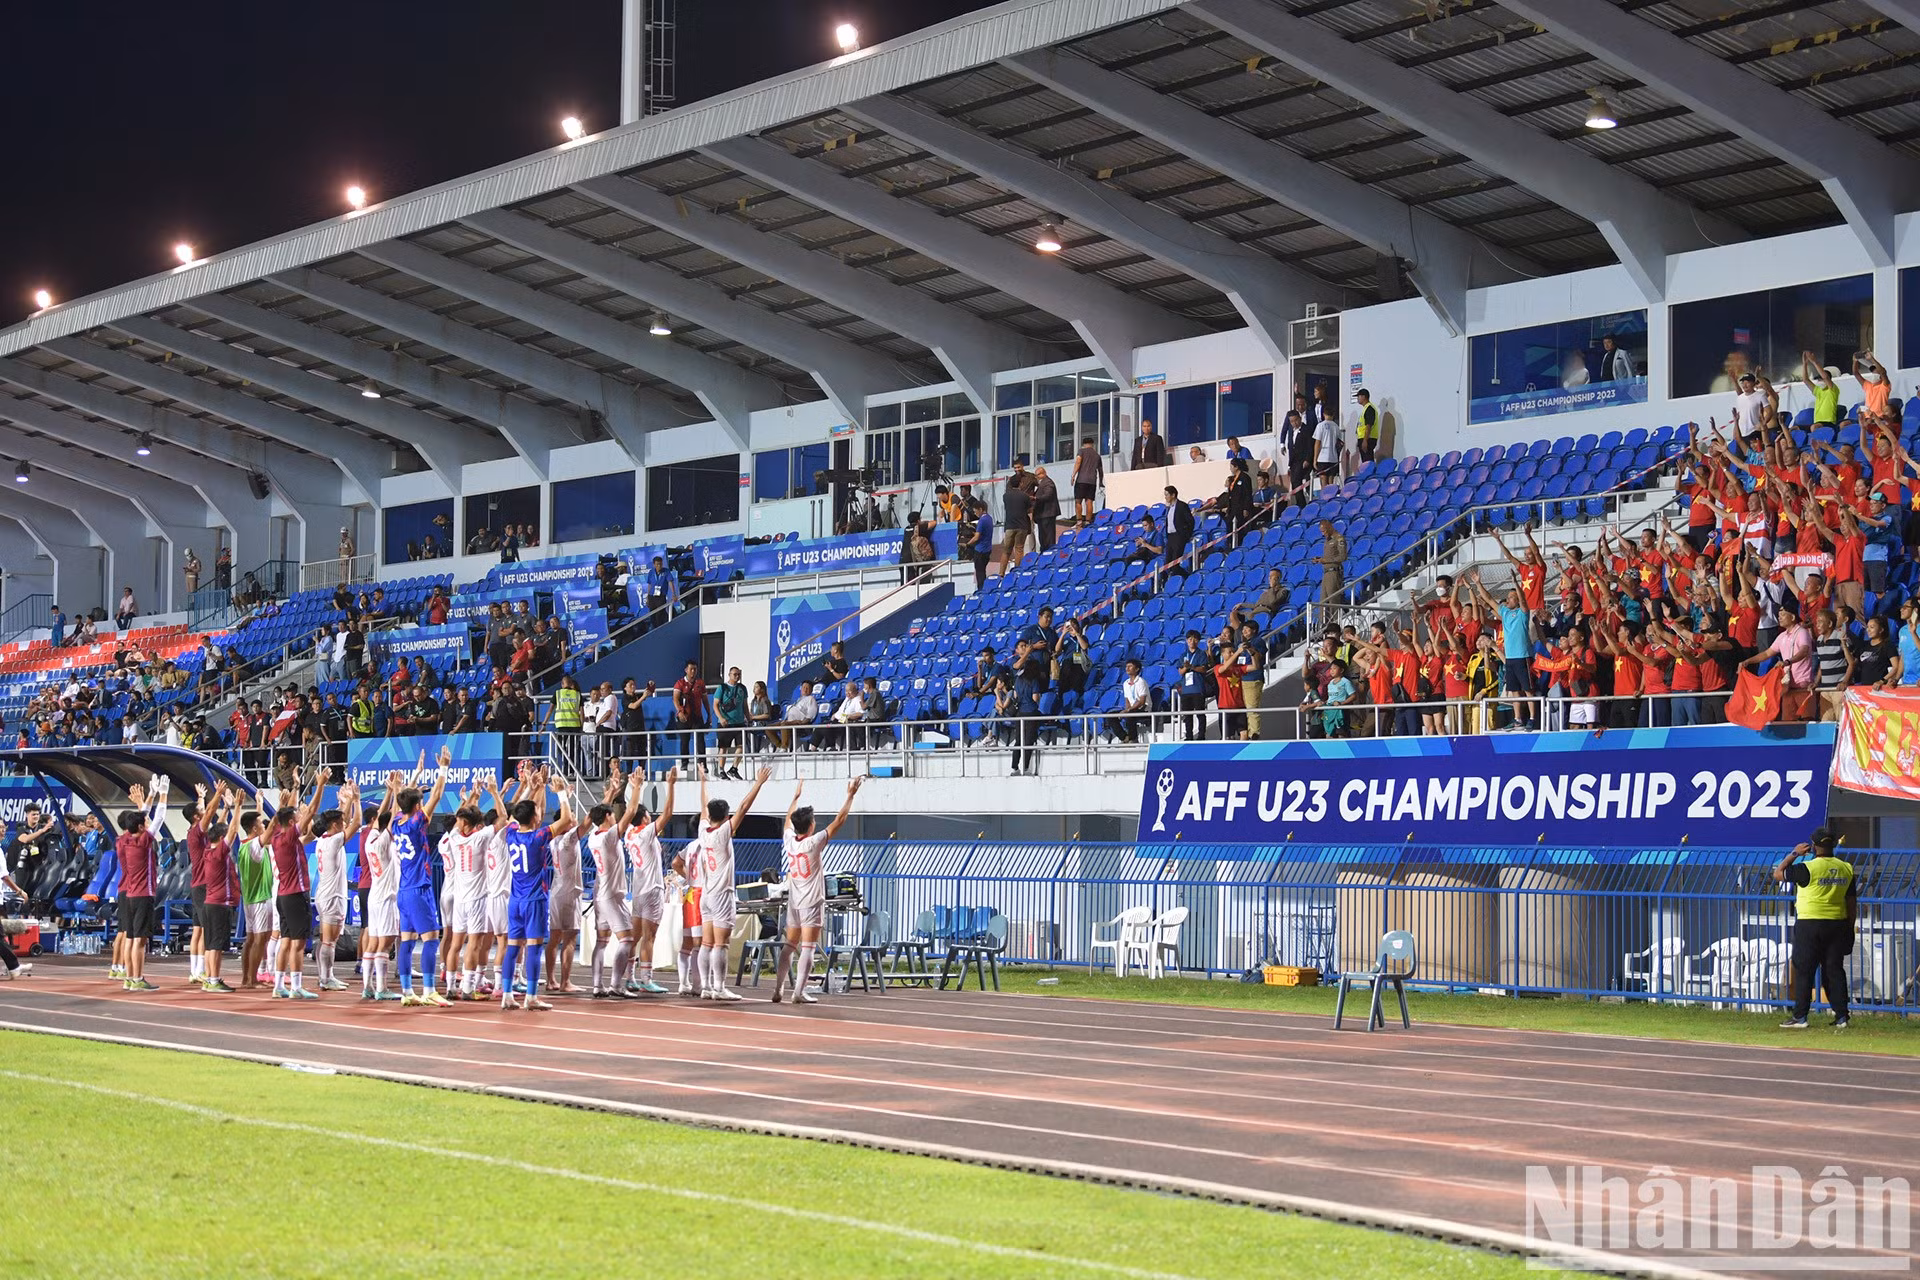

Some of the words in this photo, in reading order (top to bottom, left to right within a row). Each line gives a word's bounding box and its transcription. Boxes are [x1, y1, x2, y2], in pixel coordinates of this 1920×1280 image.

[1505, 402, 1520, 412] AFF
[1521, 400, 1536, 410] U23
[1537, 392, 1596, 408] CHAMPIONSHIP
[1596, 389, 1616, 400] 2023
[784, 552, 800, 566] AFF
[803, 551, 819, 564] U23
[821, 543, 889, 562] CHAMPIONSHIP
[891, 541, 903, 554] 20
[504, 574, 515, 584] AFF
[516, 573, 528, 583] U23
[529, 568, 576, 582] CHAMPIONSHIP
[454, 606, 466, 618] U23
[388, 642, 400, 653] U23
[401, 639, 446, 652] CHAMPIONSHIP
[448, 636, 464, 648] 2023
[808, 642, 822, 655] U23
[359, 770, 376, 785] AFF
[1176, 781, 1249, 821] AFF
[1258, 779, 1328, 821] U23
[1339, 772, 1676, 821] CHAMPIONSHIP
[1687, 769, 1813, 818] 2023
[458, 845, 473, 872] 11
[509, 843, 528, 873] 21
[788, 852, 811, 878] 20
